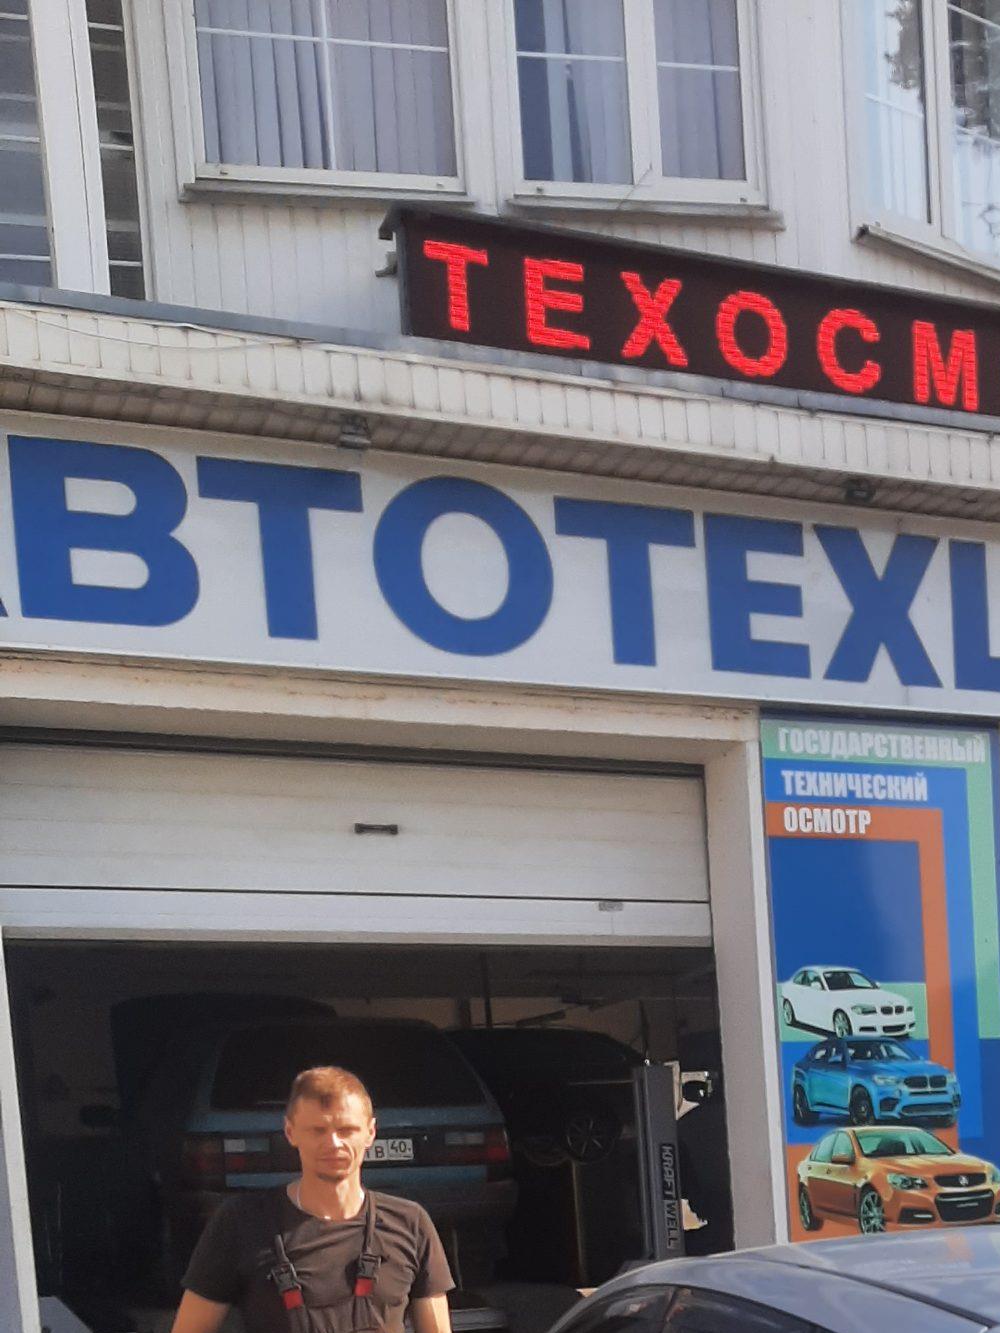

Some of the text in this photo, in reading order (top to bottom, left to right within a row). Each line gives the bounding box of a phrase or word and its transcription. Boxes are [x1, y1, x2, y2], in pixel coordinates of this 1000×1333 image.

[777, 726, 986, 763] ГОСУДАРСТВЕННЫЙ
[781, 769, 928, 801] ТЕХНИЧЕСКИЙ
[783, 806, 871, 835] ОСМОТР
[390, 1140, 407, 1152] 40
